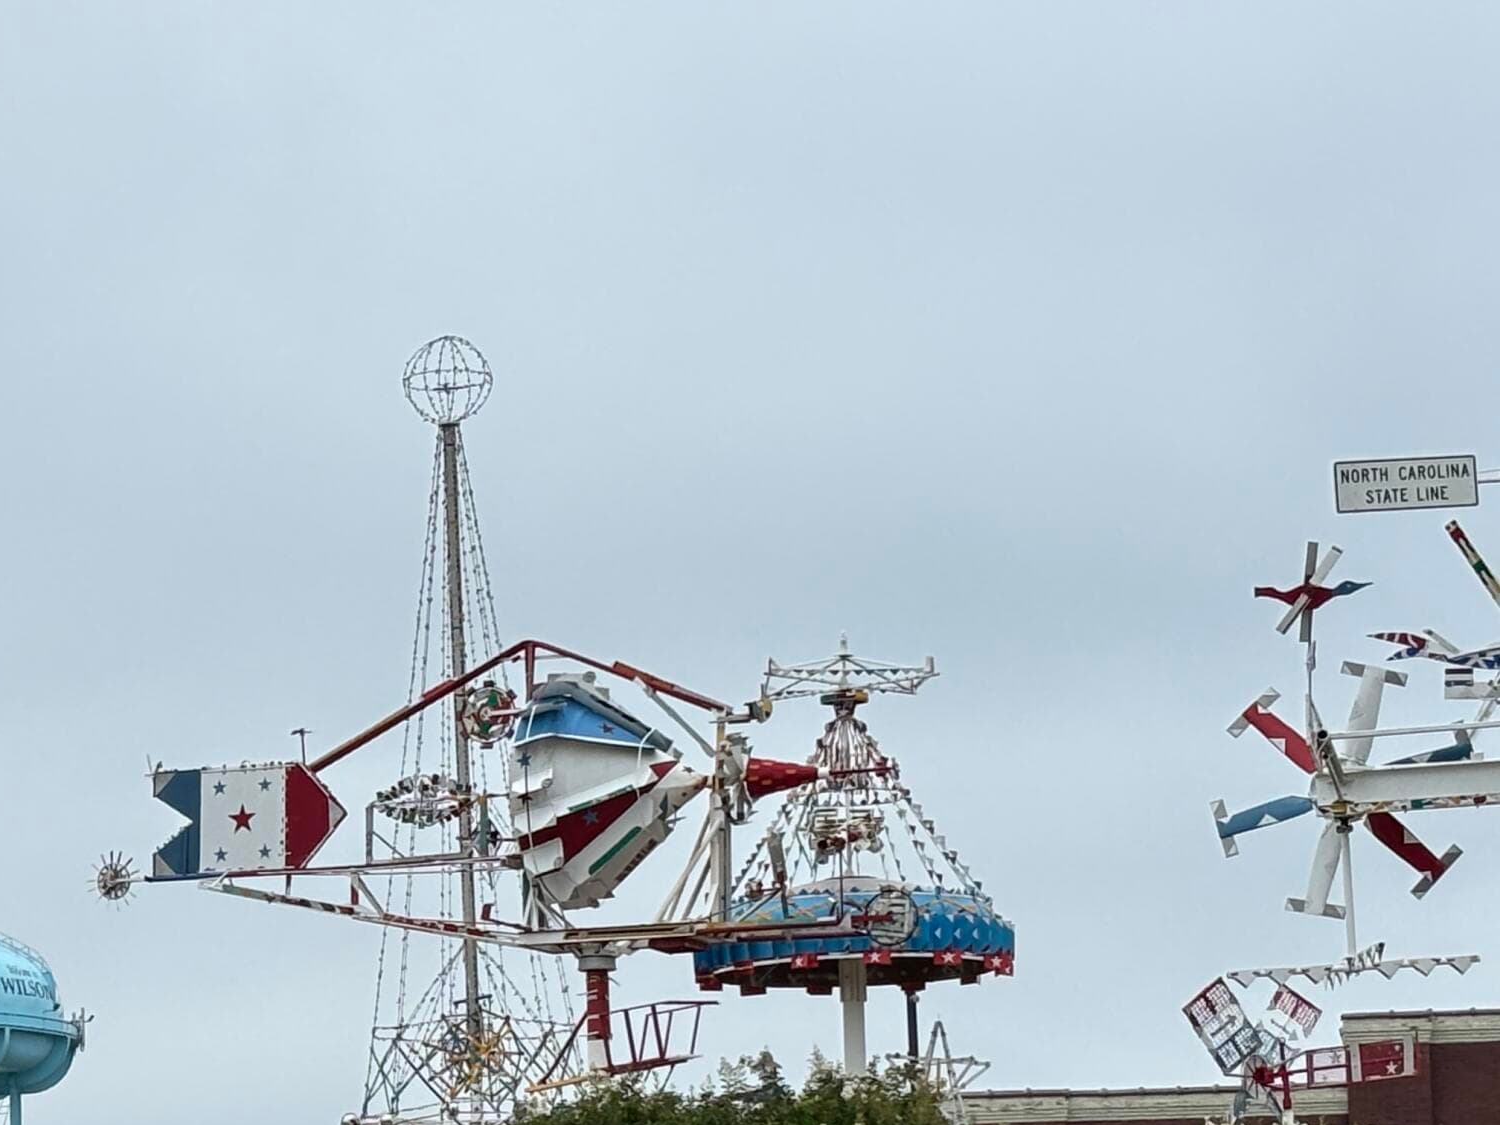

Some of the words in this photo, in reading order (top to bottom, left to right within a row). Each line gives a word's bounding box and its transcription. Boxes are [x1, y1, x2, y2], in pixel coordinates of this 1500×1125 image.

[1340, 467, 1389, 485] NORTH
[1398, 463, 1470, 481] CAROLINA
[1365, 487, 1409, 504] STATE
[1416, 485, 1450, 501] LINE
[0, 976, 54, 1001] WILSON
